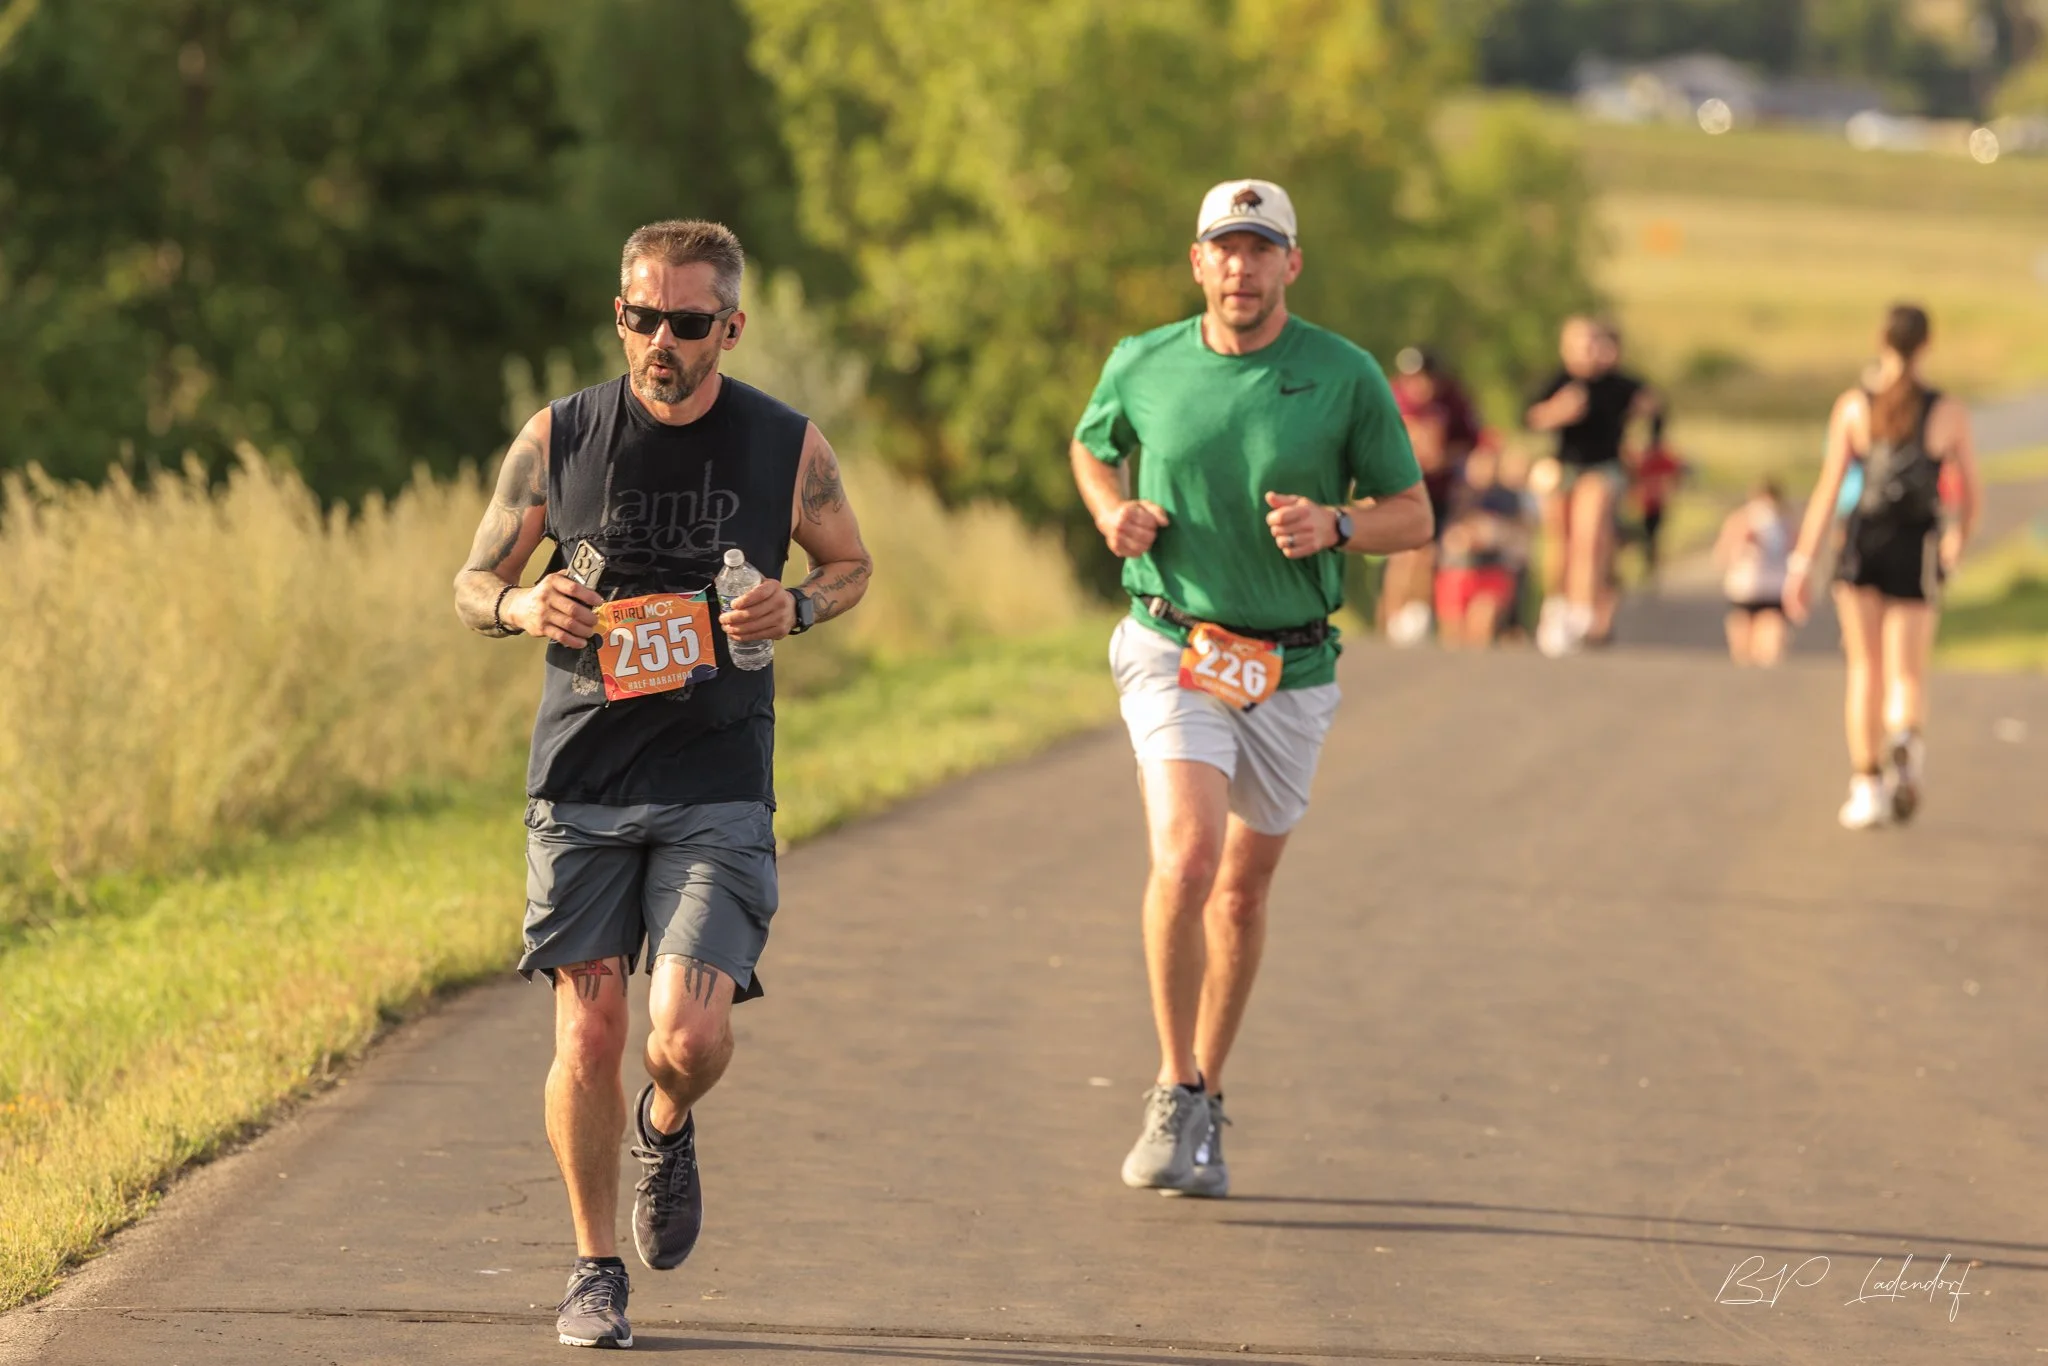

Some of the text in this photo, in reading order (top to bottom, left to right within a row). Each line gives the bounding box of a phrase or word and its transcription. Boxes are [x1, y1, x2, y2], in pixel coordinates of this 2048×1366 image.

[599, 459, 740, 542] lamb
[612, 499, 737, 567] god
[609, 616, 699, 677] 255
[1194, 637, 1267, 697] 226
[627, 670, 693, 690] HALF MARATHON
